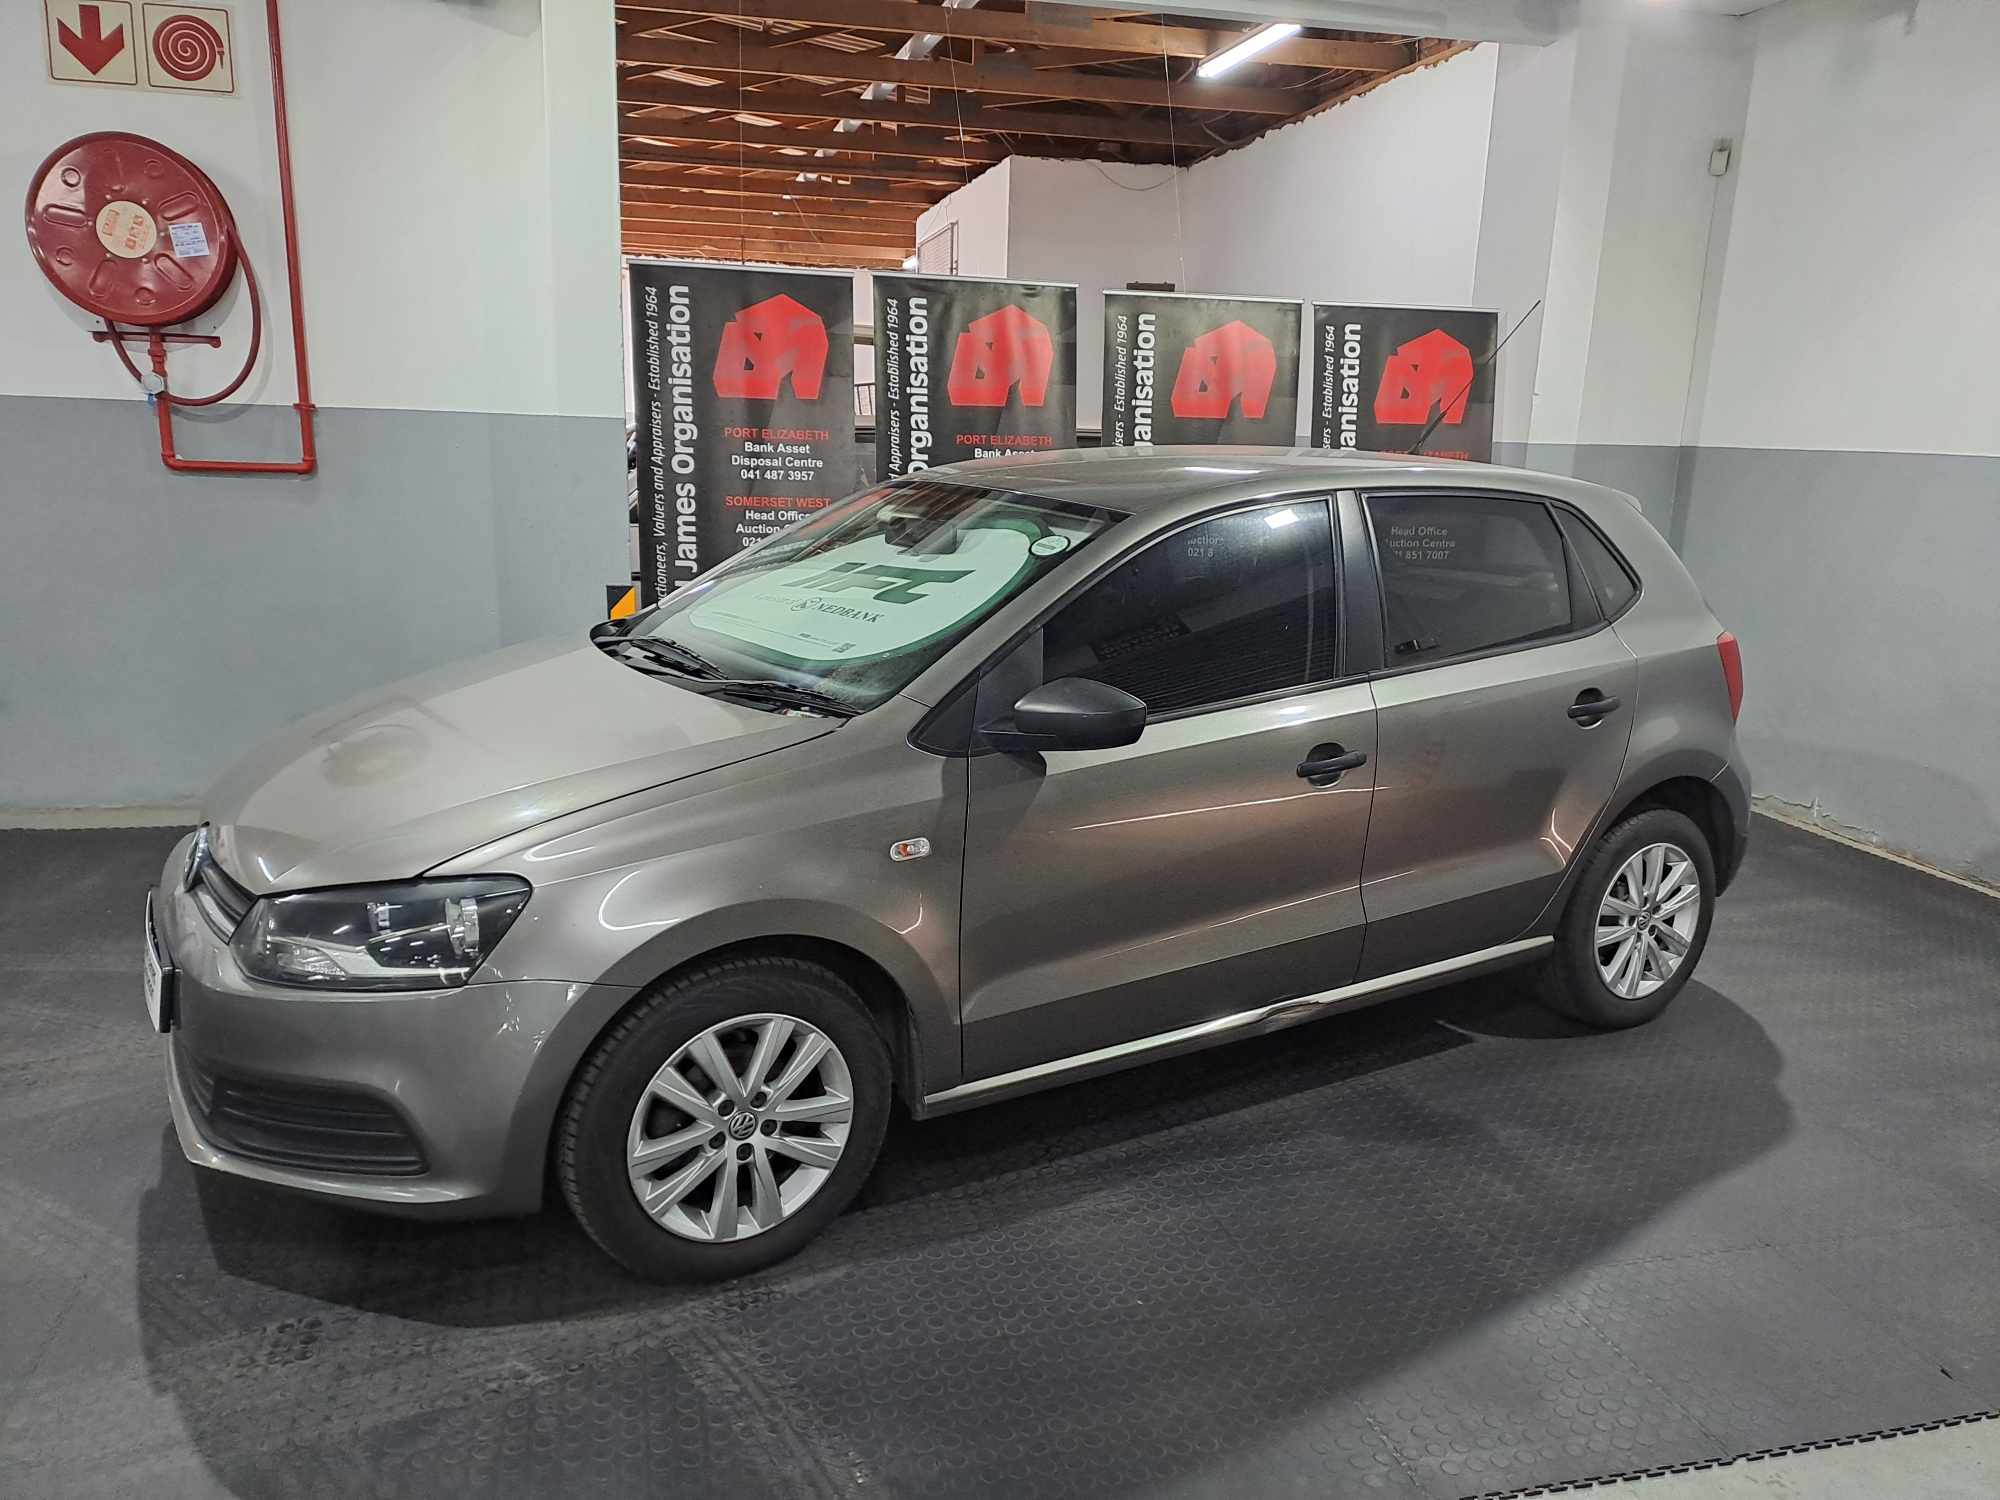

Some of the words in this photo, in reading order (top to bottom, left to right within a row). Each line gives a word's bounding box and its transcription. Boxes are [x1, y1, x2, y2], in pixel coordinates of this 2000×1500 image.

[645, 286, 658, 317] 1964
[887, 297, 899, 331] 1964
[1116, 315, 1128, 343] 1964
[1325, 325, 1336, 353] 1964
[645, 320, 660, 391] Established
[887, 332, 900, 400] Established
[666, 285, 698, 474] Organisation
[1114, 345, 1127, 412] Established
[1131, 313, 1157, 447] anisation
[1322, 355, 1334, 418] Established
[1338, 322, 1362, 450] anisation
[649, 401, 666, 465] Appraisers
[724, 427, 759, 438] PORT
[761, 428, 829, 440] ELIZABETH
[888, 409, 902, 472] Appraisers
[956, 435, 986, 445] PORT
[990, 435, 1053, 446] ELIZABETH
[731, 455, 782, 468] Disposal
[785, 457, 823, 468] Centre
[744, 442, 774, 453] Bank
[776, 443, 811, 454] Asset
[974, 448, 1001, 459] Bank
[651, 466, 664, 490] and
[740, 469, 760, 480] 041
[764, 470, 784, 480] 487
[788, 470, 815, 481] 3957
[652, 493, 665, 536] Valuers
[725, 496, 793, 507] SOMERSET
[796, 497, 831, 508] WEST
[745, 510, 775, 520] Head
[675, 483, 698, 573] James
[735, 523, 780, 534] Auction
[1391, 526, 1416, 536] Head
[1418, 526, 1449, 536] Office
[1386, 538, 1420, 548] uction
[1426, 550, 1450, 560] 7007
[654, 542, 668, 600] ctioneers,
[814, 601, 885, 624] NEDBANK
